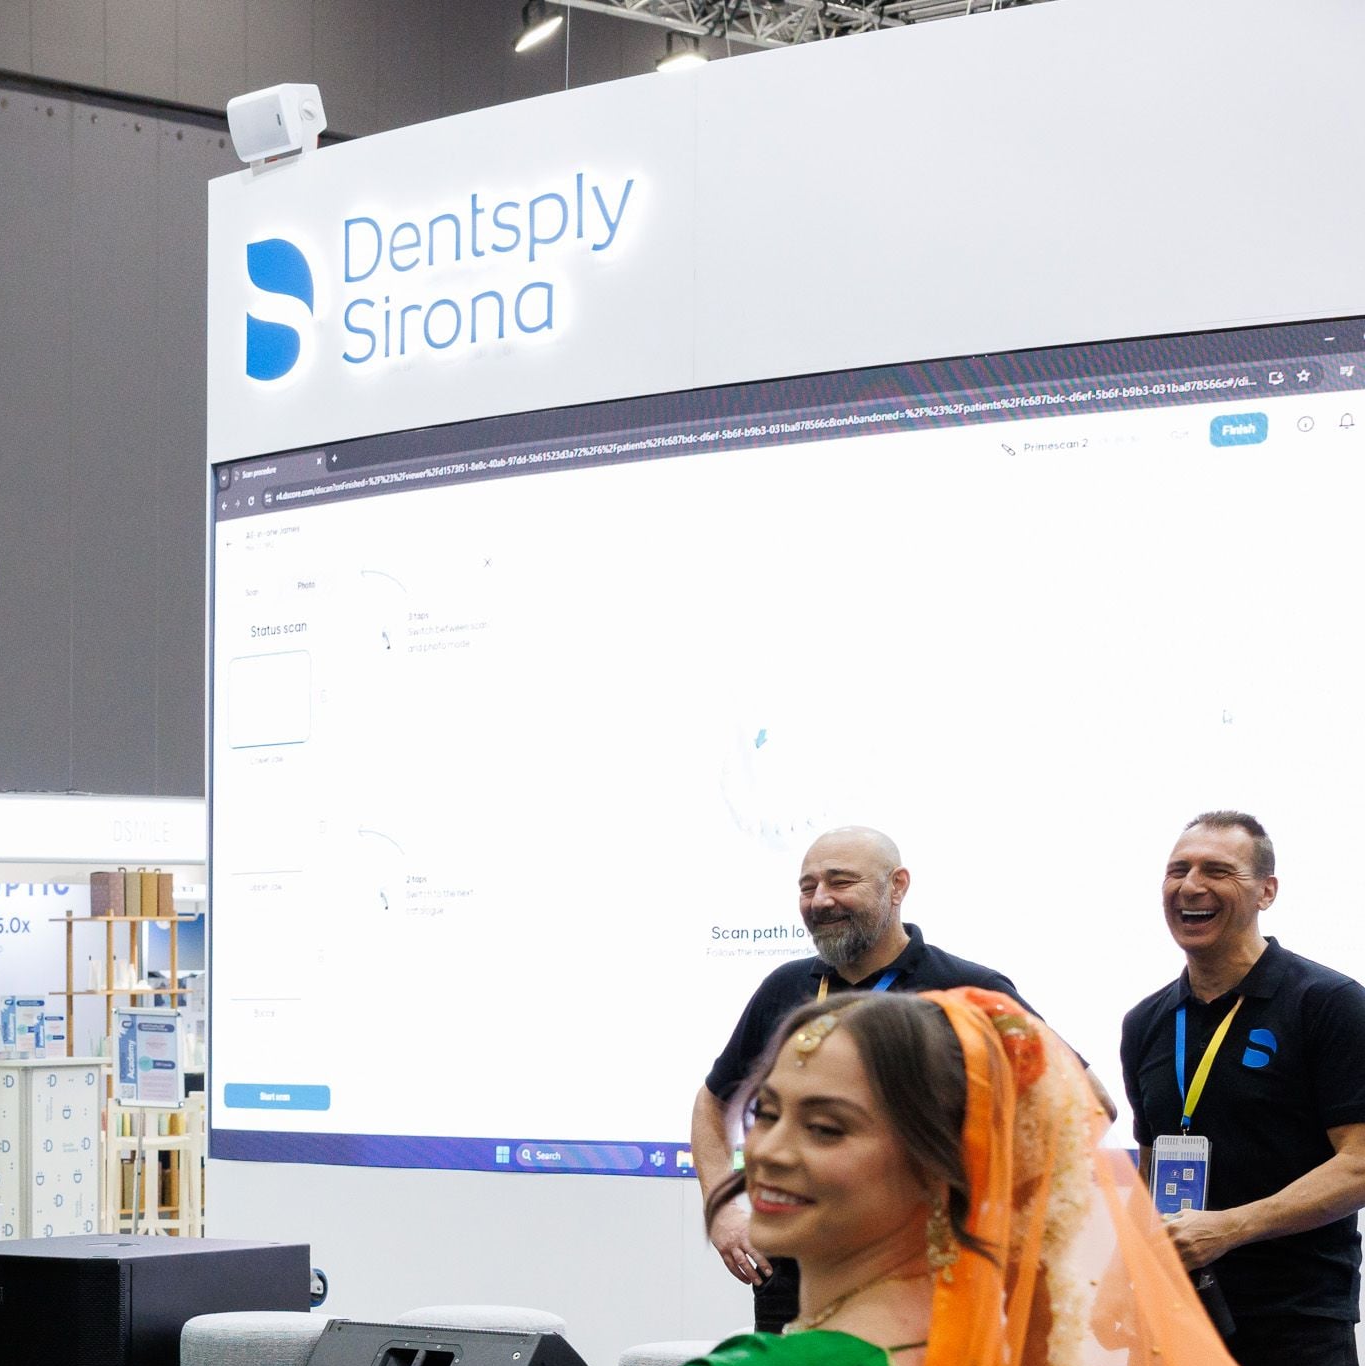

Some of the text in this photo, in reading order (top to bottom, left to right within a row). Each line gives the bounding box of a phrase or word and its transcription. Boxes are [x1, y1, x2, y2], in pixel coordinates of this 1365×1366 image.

[344, 172, 635, 282] Dentsply
[341, 281, 554, 364] Sirona
[1222, 423, 1256, 436] Finish
[1023, 438, 1089, 452] Primescan 2
[297, 580, 316, 590] Photo
[250, 621, 308, 639] Status scan
[412, 875, 428, 885] taps
[711, 924, 811, 942] Scan path lo
[706, 948, 736, 957] Follow
[736, 947, 752, 956] the
[535, 1150, 561, 1161] Search
